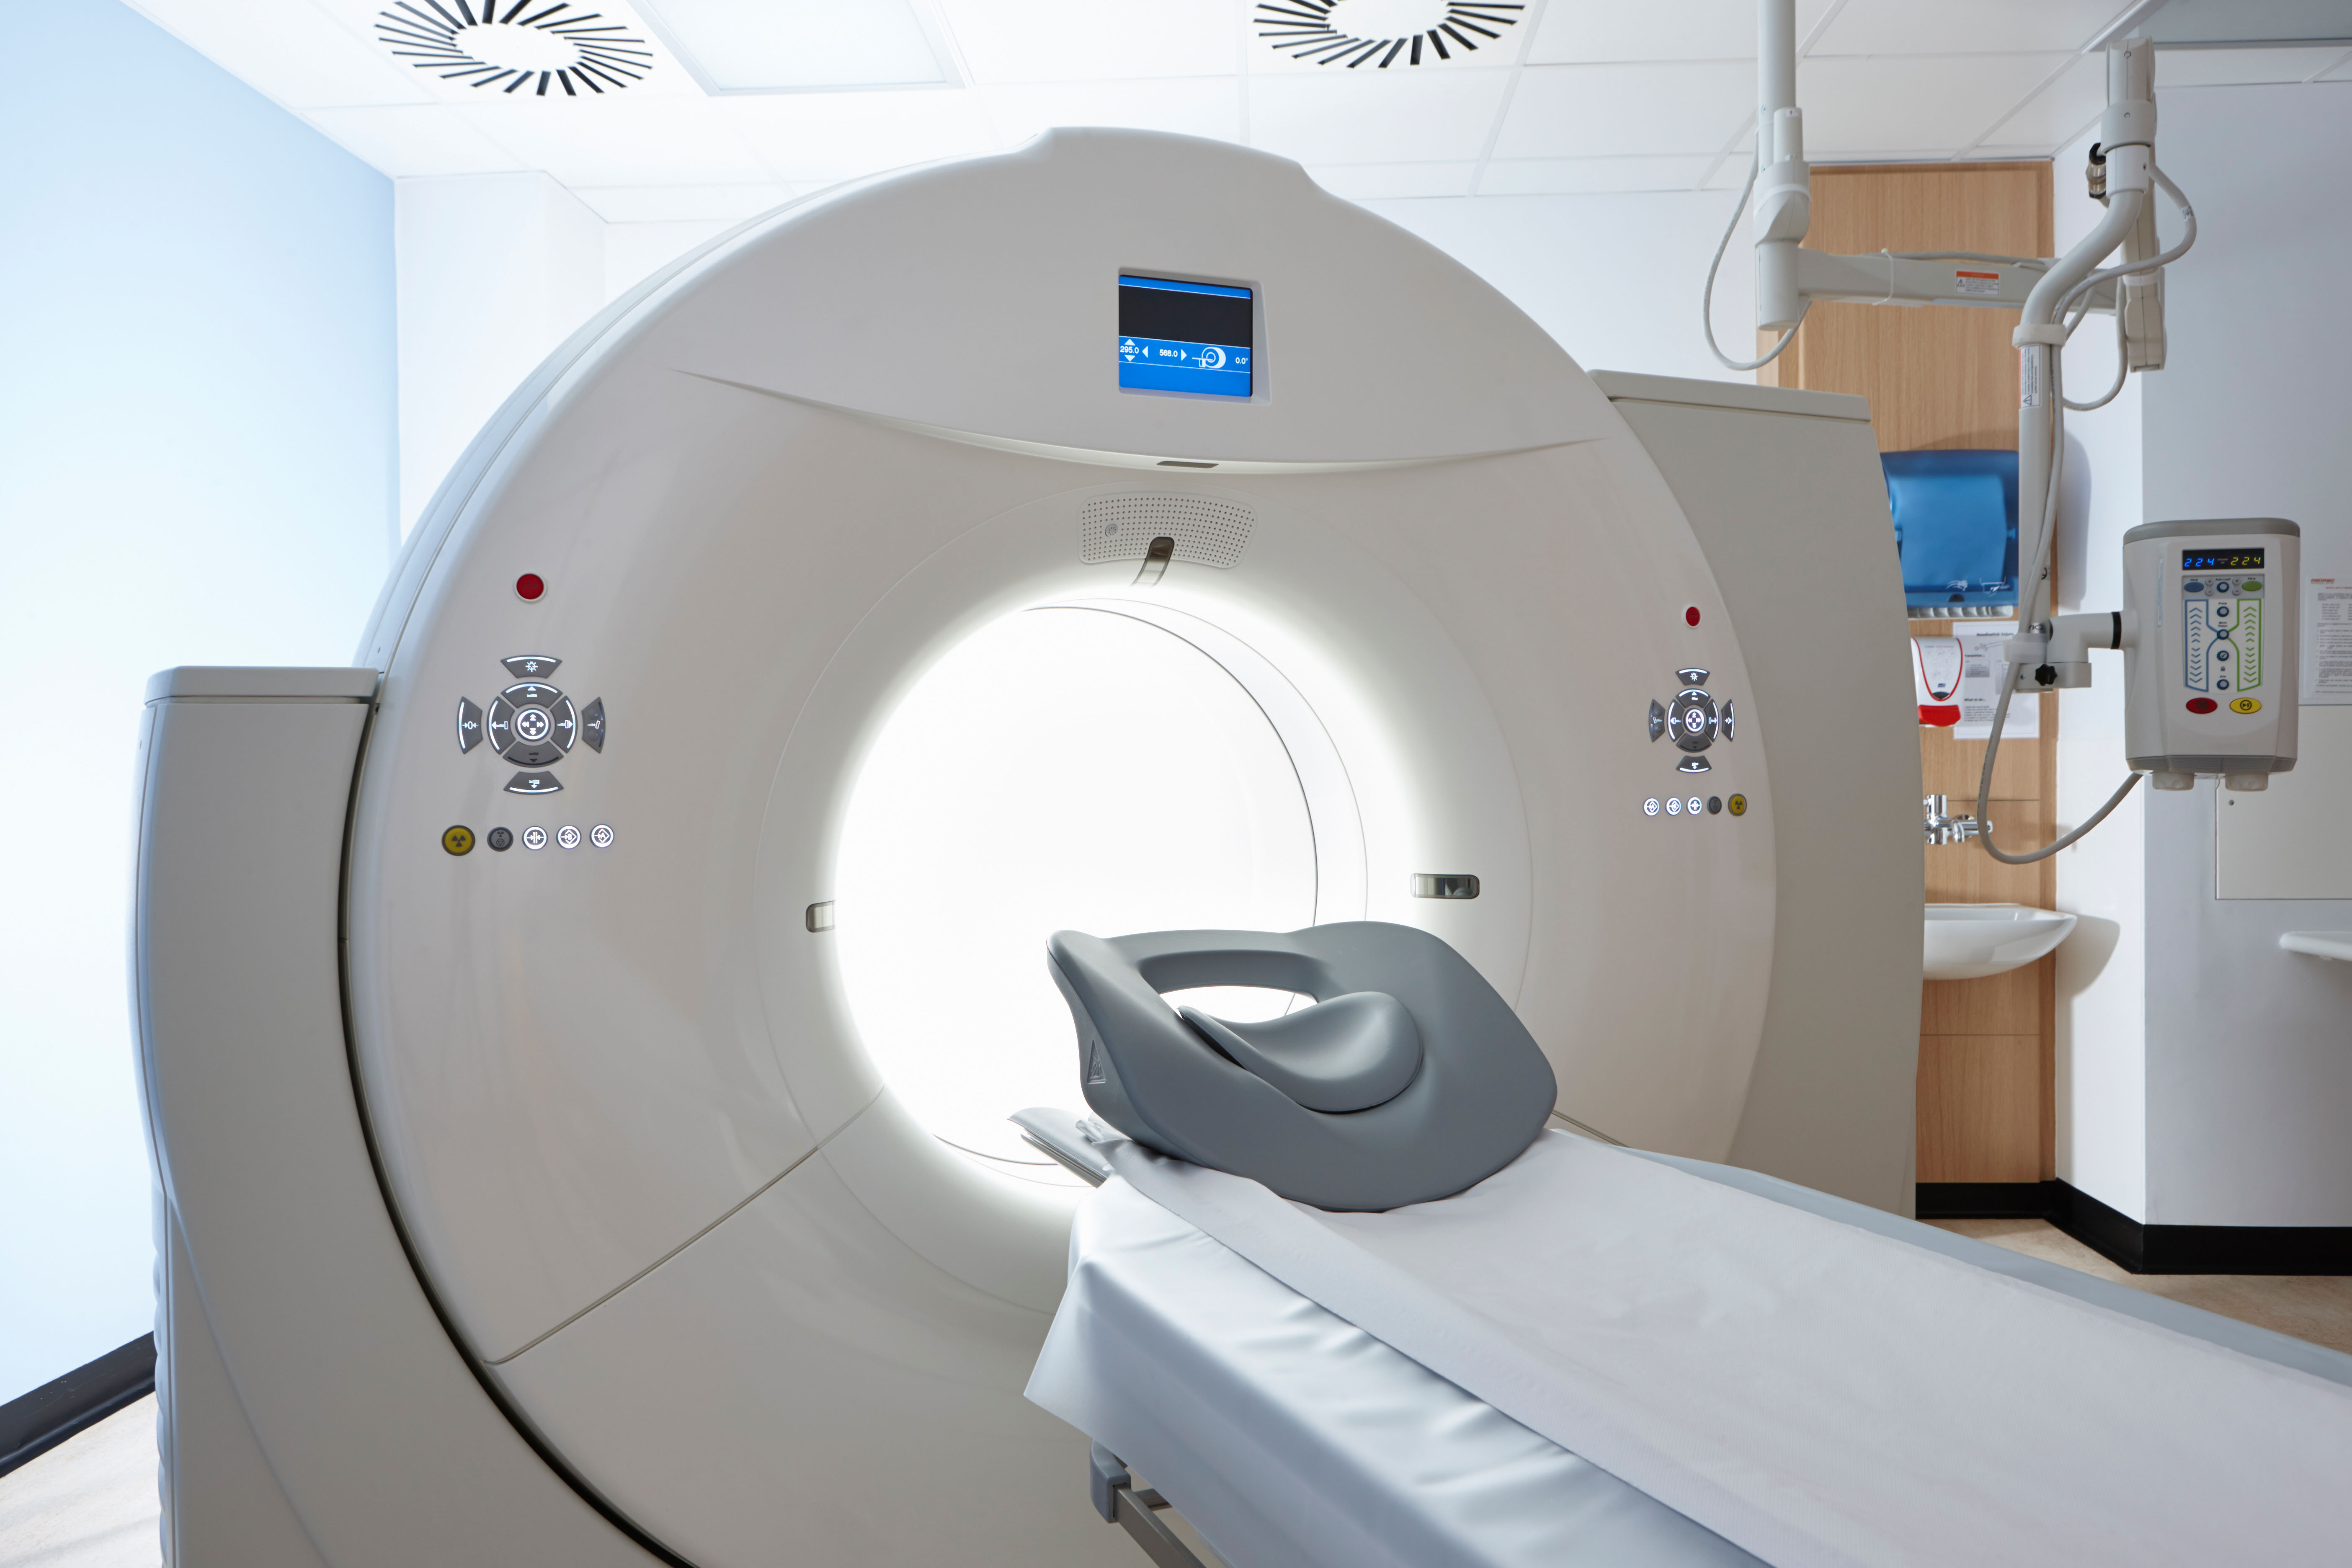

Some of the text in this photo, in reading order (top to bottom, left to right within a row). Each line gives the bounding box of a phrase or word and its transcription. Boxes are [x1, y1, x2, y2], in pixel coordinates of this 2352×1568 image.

[1120, 346, 1139, 354] 295.0
[1159, 349, 1178, 357] 568.0
[2184, 558, 2215, 567] 224
[2231, 557, 2261, 566] 224
